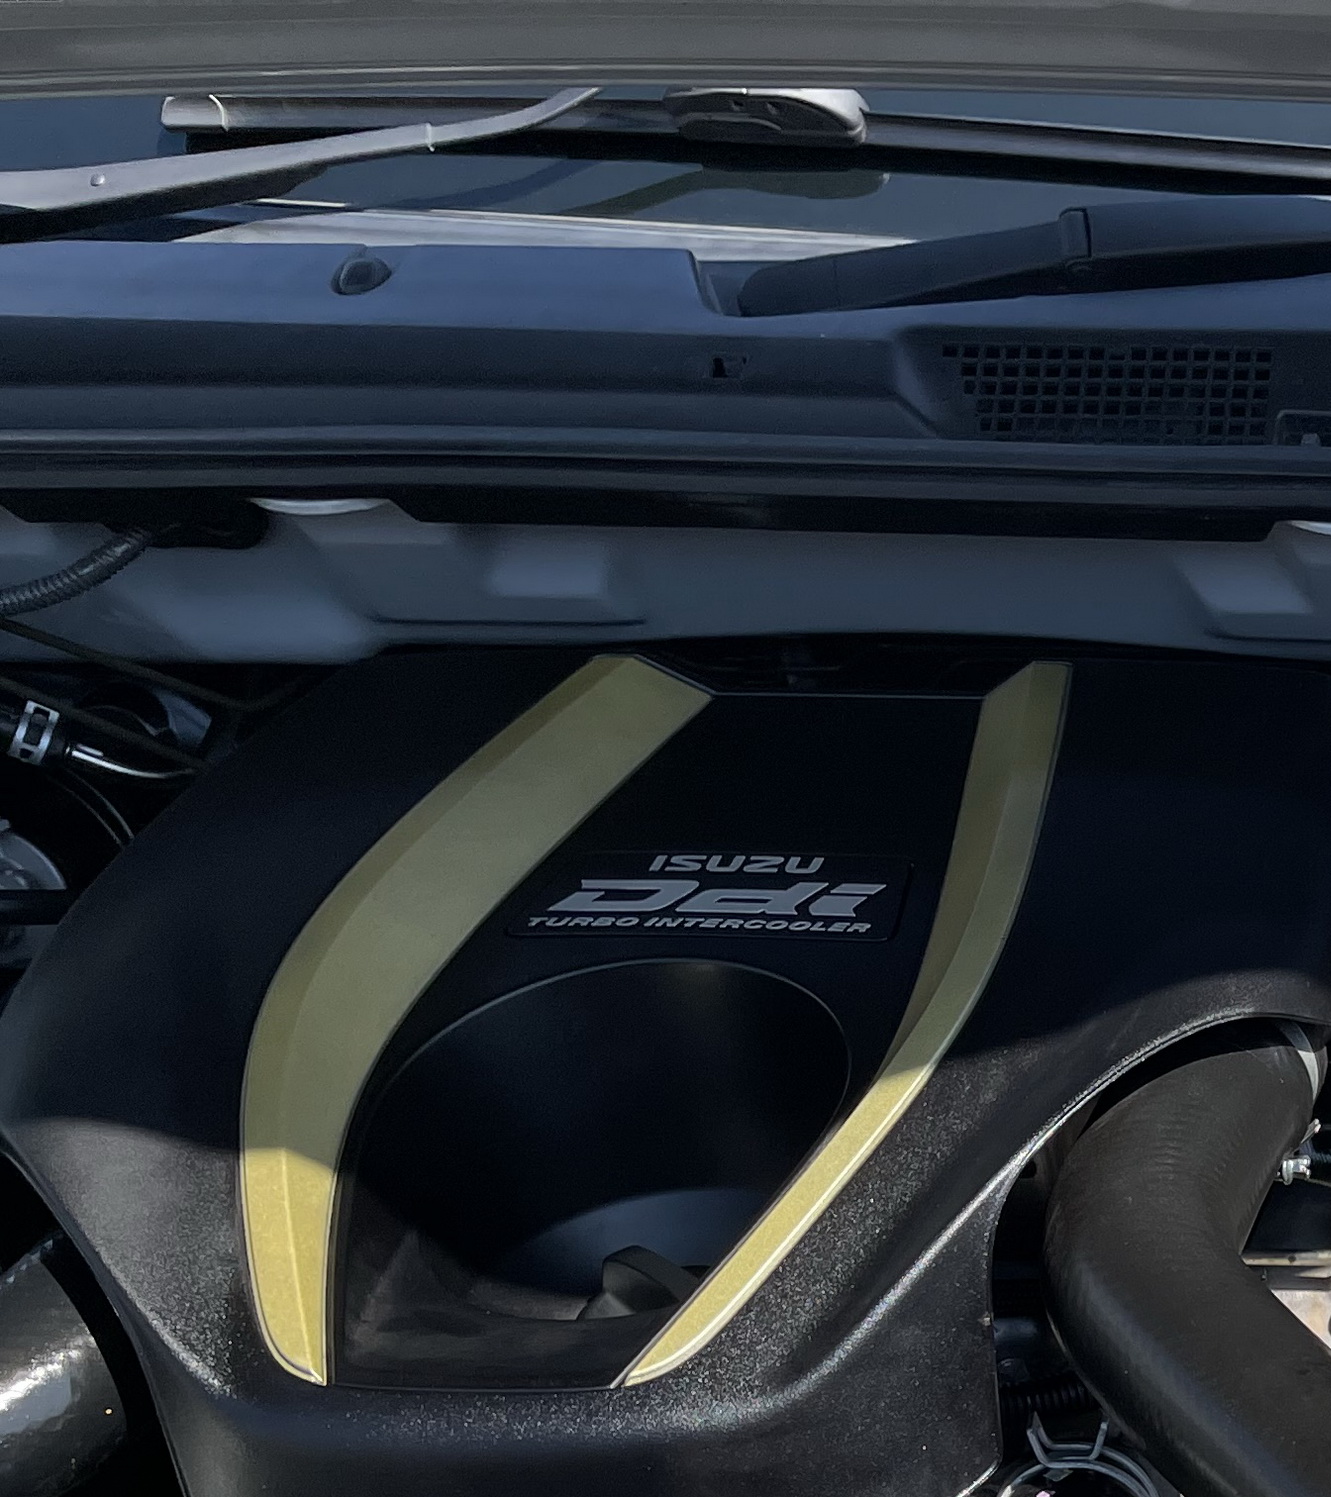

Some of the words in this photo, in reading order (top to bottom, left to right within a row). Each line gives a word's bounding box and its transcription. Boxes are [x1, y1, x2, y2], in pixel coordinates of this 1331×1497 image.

[649, 855, 824, 874] ISUZU
[528, 917, 639, 928] TURBO
[645, 918, 872, 933] INTERCOOLER
